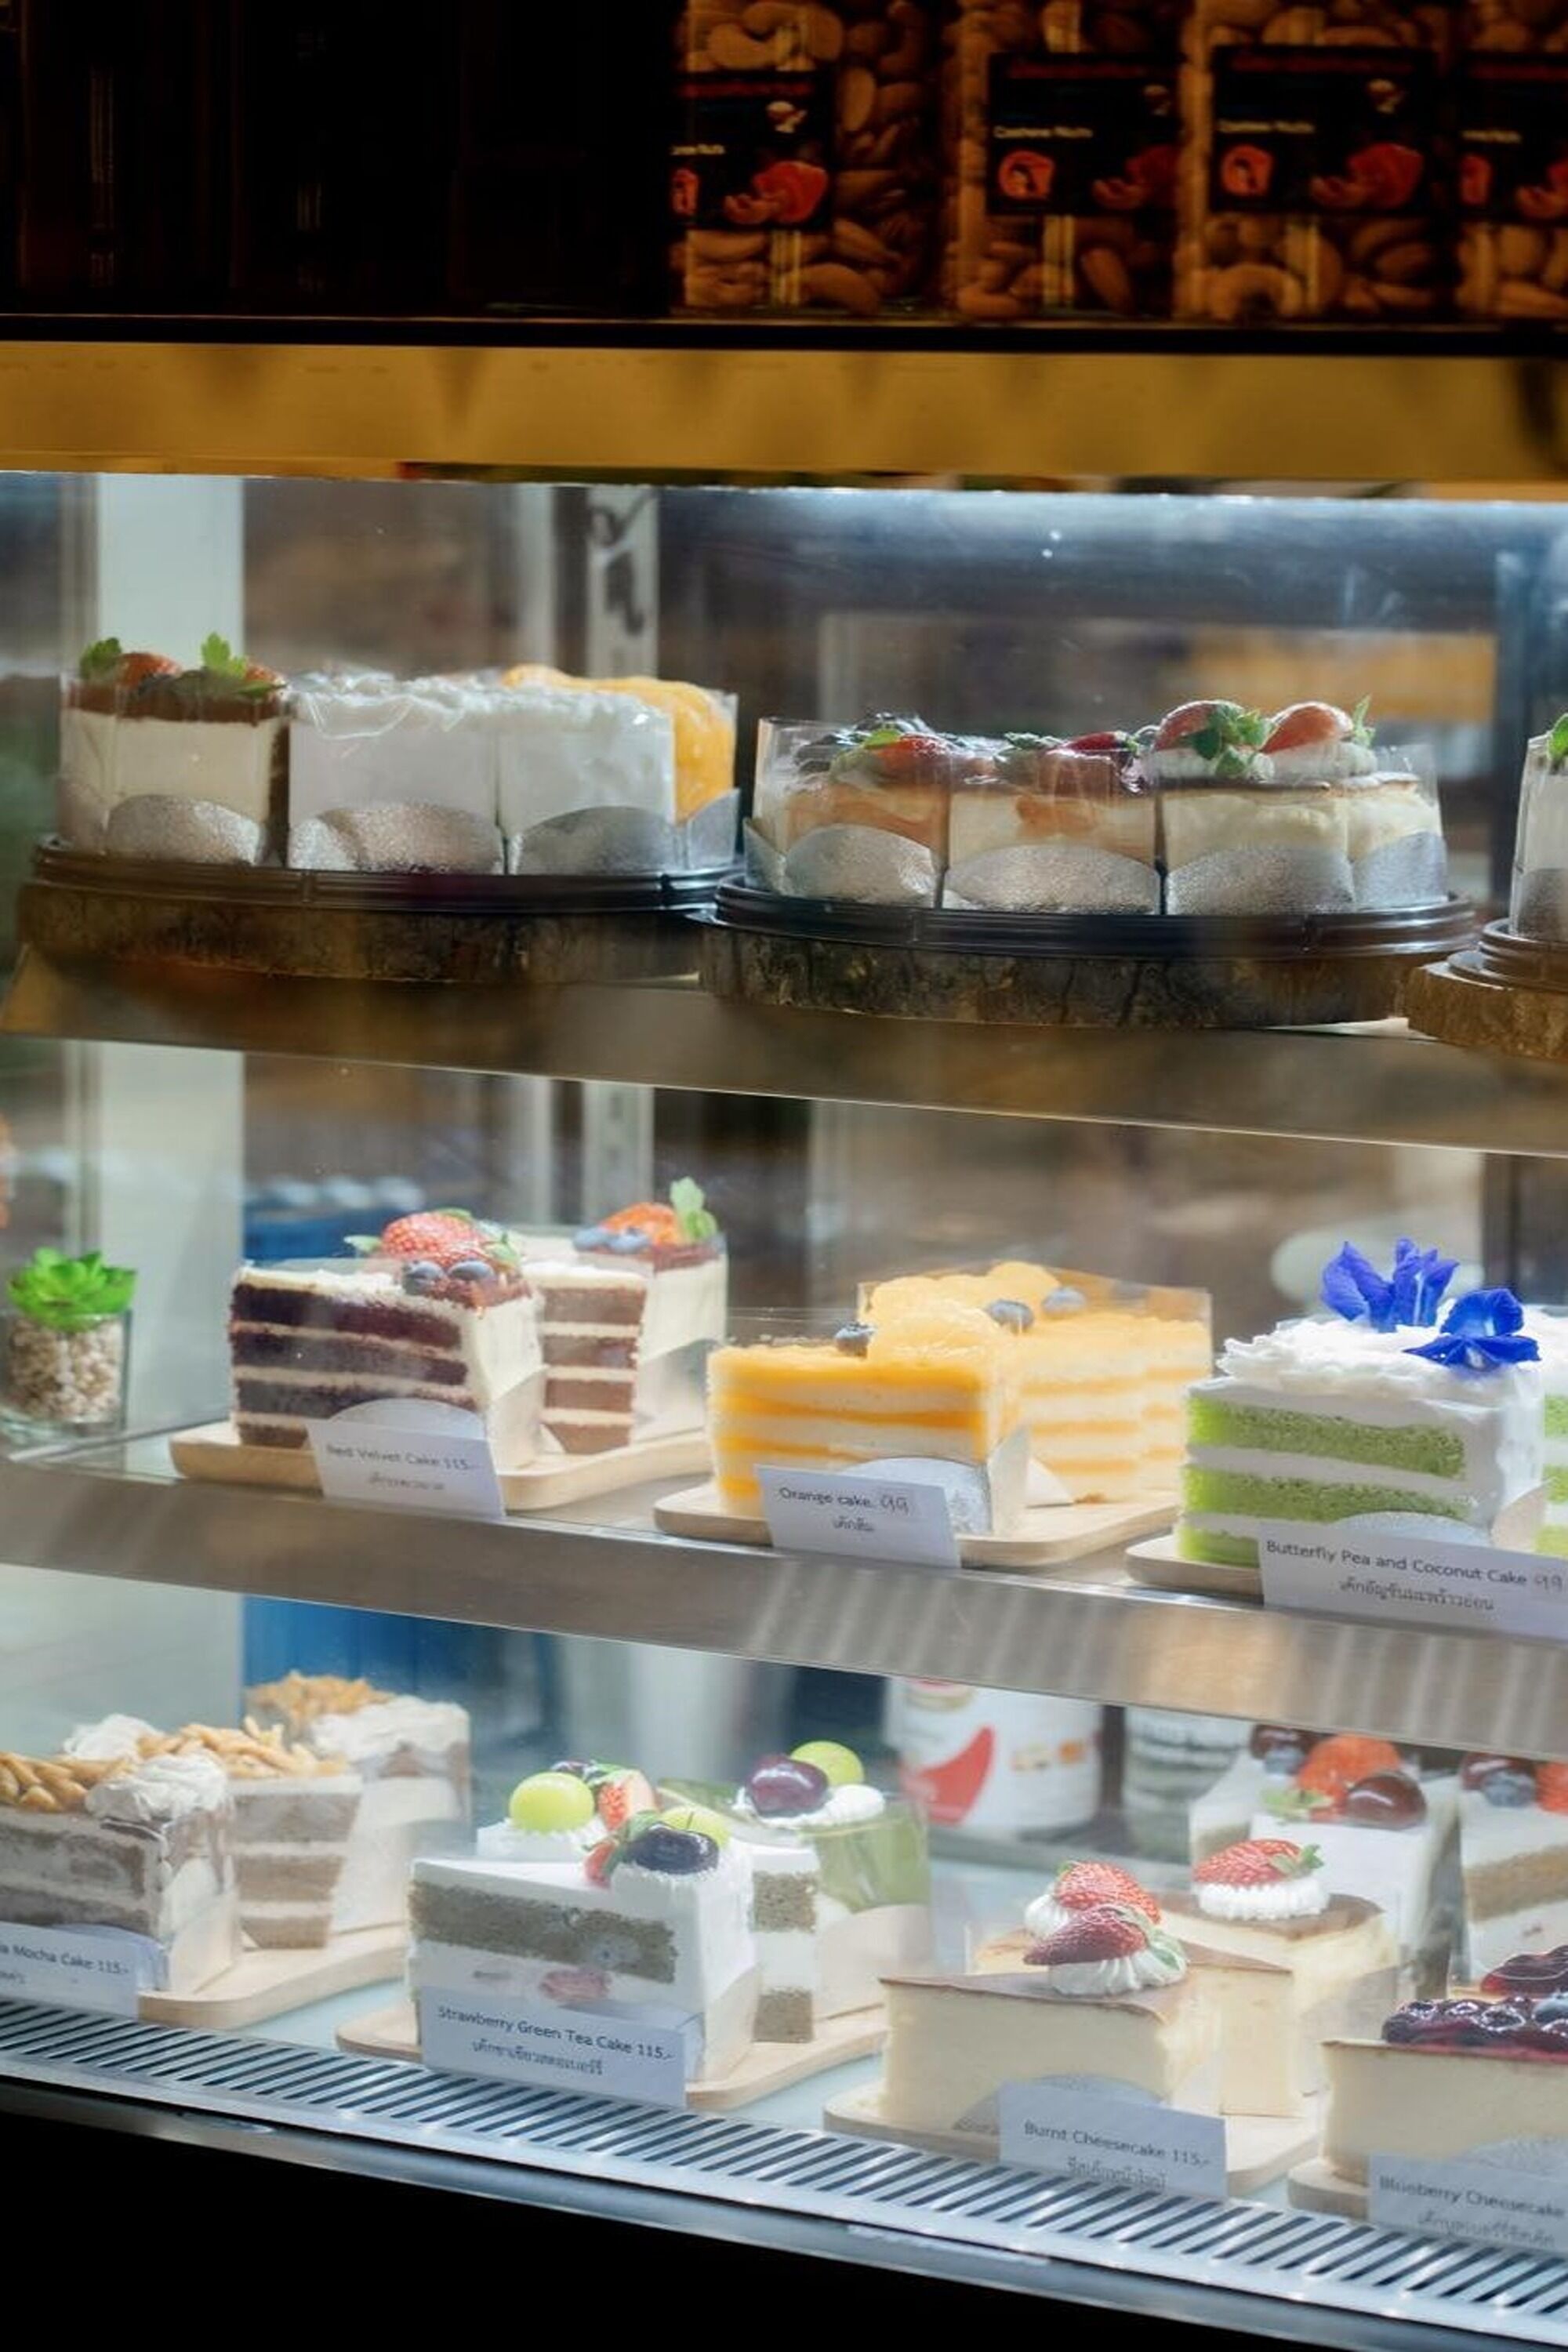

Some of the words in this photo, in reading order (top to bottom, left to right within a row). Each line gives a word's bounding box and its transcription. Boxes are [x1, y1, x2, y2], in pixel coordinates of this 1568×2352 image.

[326, 1445, 354, 1459] Red
[356, 1449, 401, 1463] Velvet
[406, 1451, 440, 1468] Cake
[779, 1486, 833, 1505] Orange
[1266, 1540, 1337, 1563] Butterfly
[1341, 1550, 1371, 1566] Pea
[1375, 1555, 1407, 1570] and
[1413, 1560, 1483, 1581] Coconut
[1486, 1569, 1527, 1585] Cake
[13, 1944, 56, 1962] Mocha
[62, 1953, 95, 1969] Cake
[438, 2005, 514, 2033] Strawberry
[517, 2020, 562, 2040] Green
[565, 2029, 593, 2045] Tea
[597, 2036, 633, 2053] Cake
[1025, 2120, 1067, 2141] Burnt
[1073, 2129, 1167, 2158] Cheesecake
[1380, 2176, 1462, 2204] Blueberry
[1466, 2190, 1565, 2218] Cheesecake
